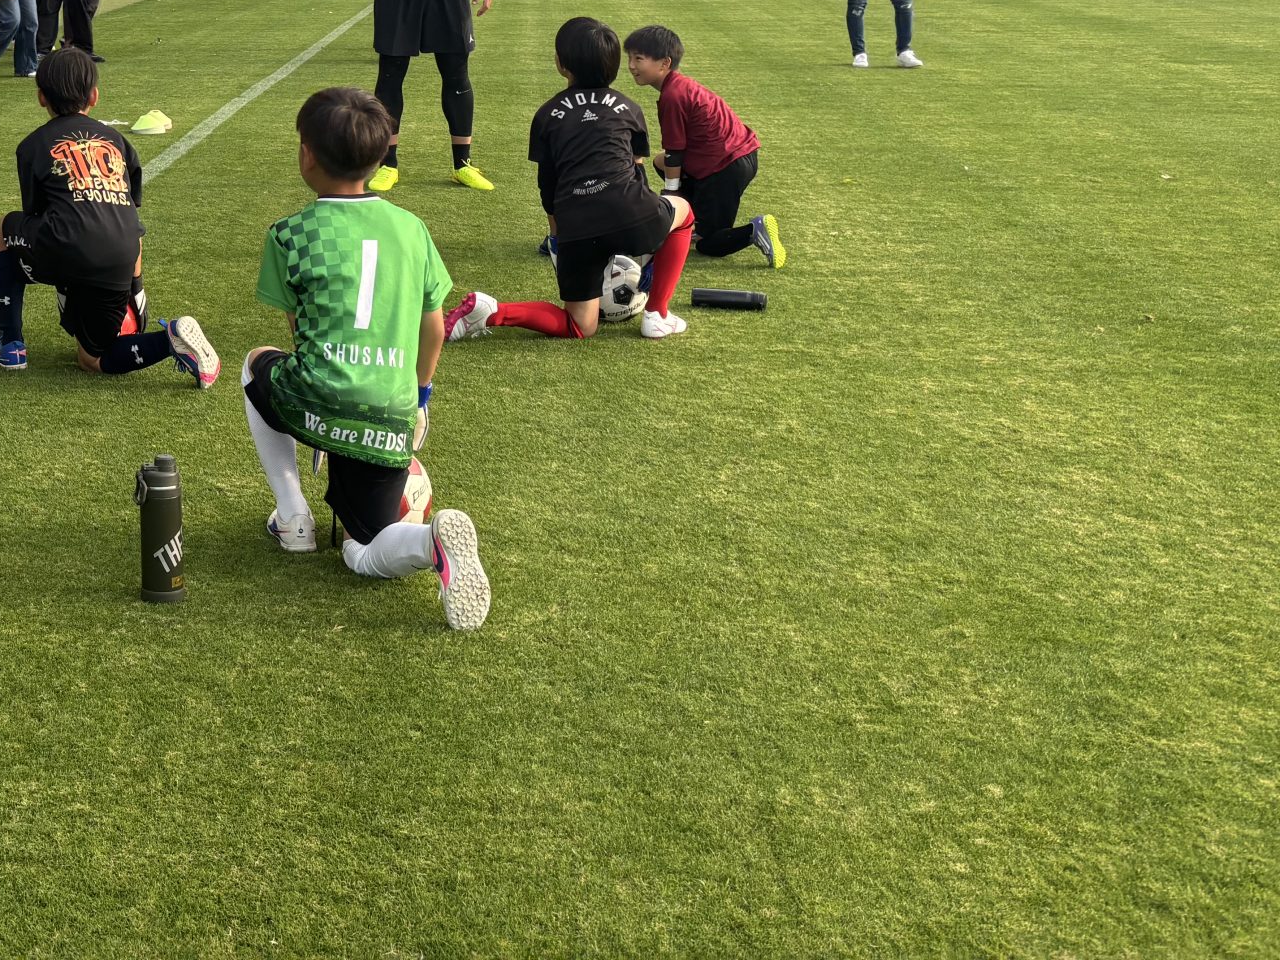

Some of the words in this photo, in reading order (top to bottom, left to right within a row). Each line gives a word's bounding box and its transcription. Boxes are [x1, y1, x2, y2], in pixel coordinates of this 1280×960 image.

[550, 92, 629, 119] SVOLME
[354, 240, 378, 329] 1
[304, 411, 327, 437] We
[330, 426, 358, 443] are
